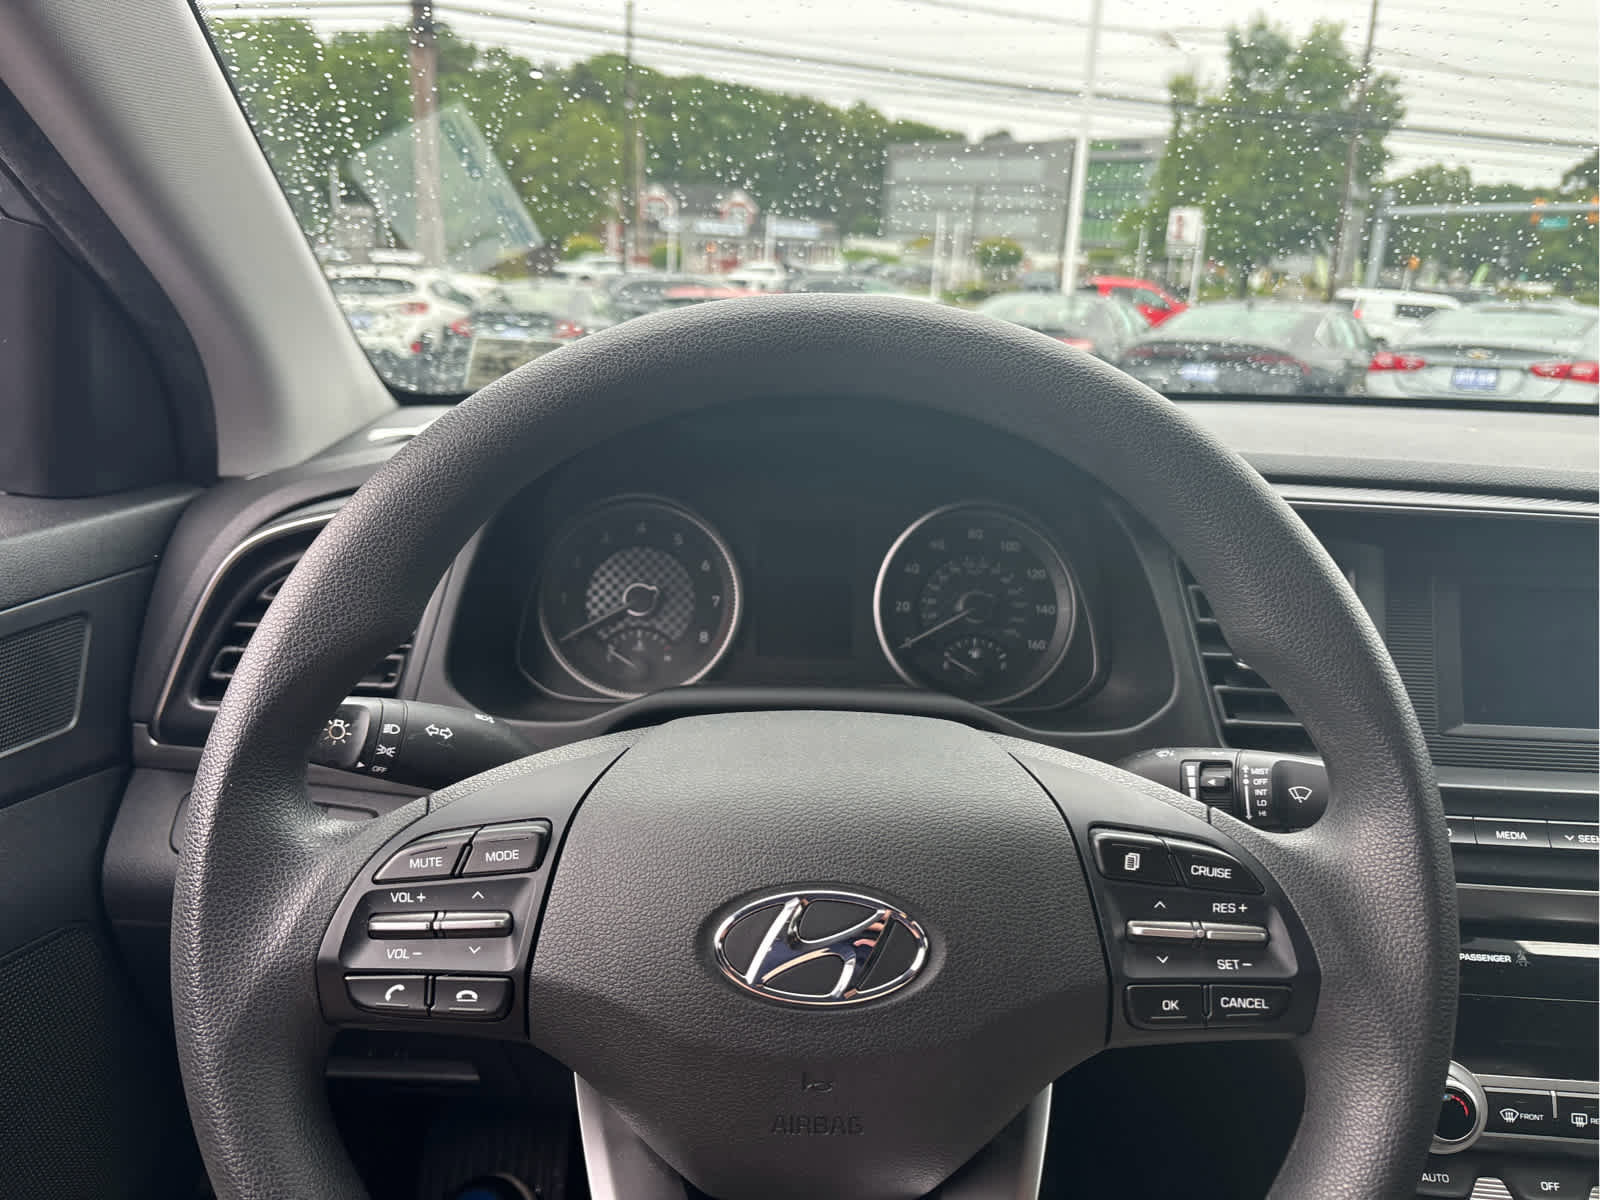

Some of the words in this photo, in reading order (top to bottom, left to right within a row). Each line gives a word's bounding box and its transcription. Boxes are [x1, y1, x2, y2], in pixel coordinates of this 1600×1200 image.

[701, 559, 711, 571] 6
[1026, 568, 1047, 580] 120
[711, 595, 721, 607] 7
[895, 600, 911, 613] 20
[1035, 604, 1056, 616] 140
[698, 631, 709, 643] 8
[1027, 639, 1048, 651] 160
[371, 765, 388, 774] OFF
[1250, 767, 1270, 776] MIST
[1252, 778, 1268, 786] OFF
[1254, 788, 1268, 797] INT
[1256, 799, 1268, 808] LO
[1495, 830, 1528, 841] MEDIA
[1577, 834, 1599, 844] SEE
[485, 849, 520, 862] MODE
[409, 856, 443, 869] MUTE
[1190, 864, 1232, 879] CRUISE
[1459, 952, 1513, 964] PASSENGER
[1161, 999, 1180, 1011] OK
[1220, 996, 1270, 1010] CANCEL
[1519, 1112, 1545, 1122] FRONT
[769, 1111, 865, 1137] AIRBAG
[1421, 1172, 1450, 1184] AUTO
[1540, 1181, 1561, 1192] OFF
